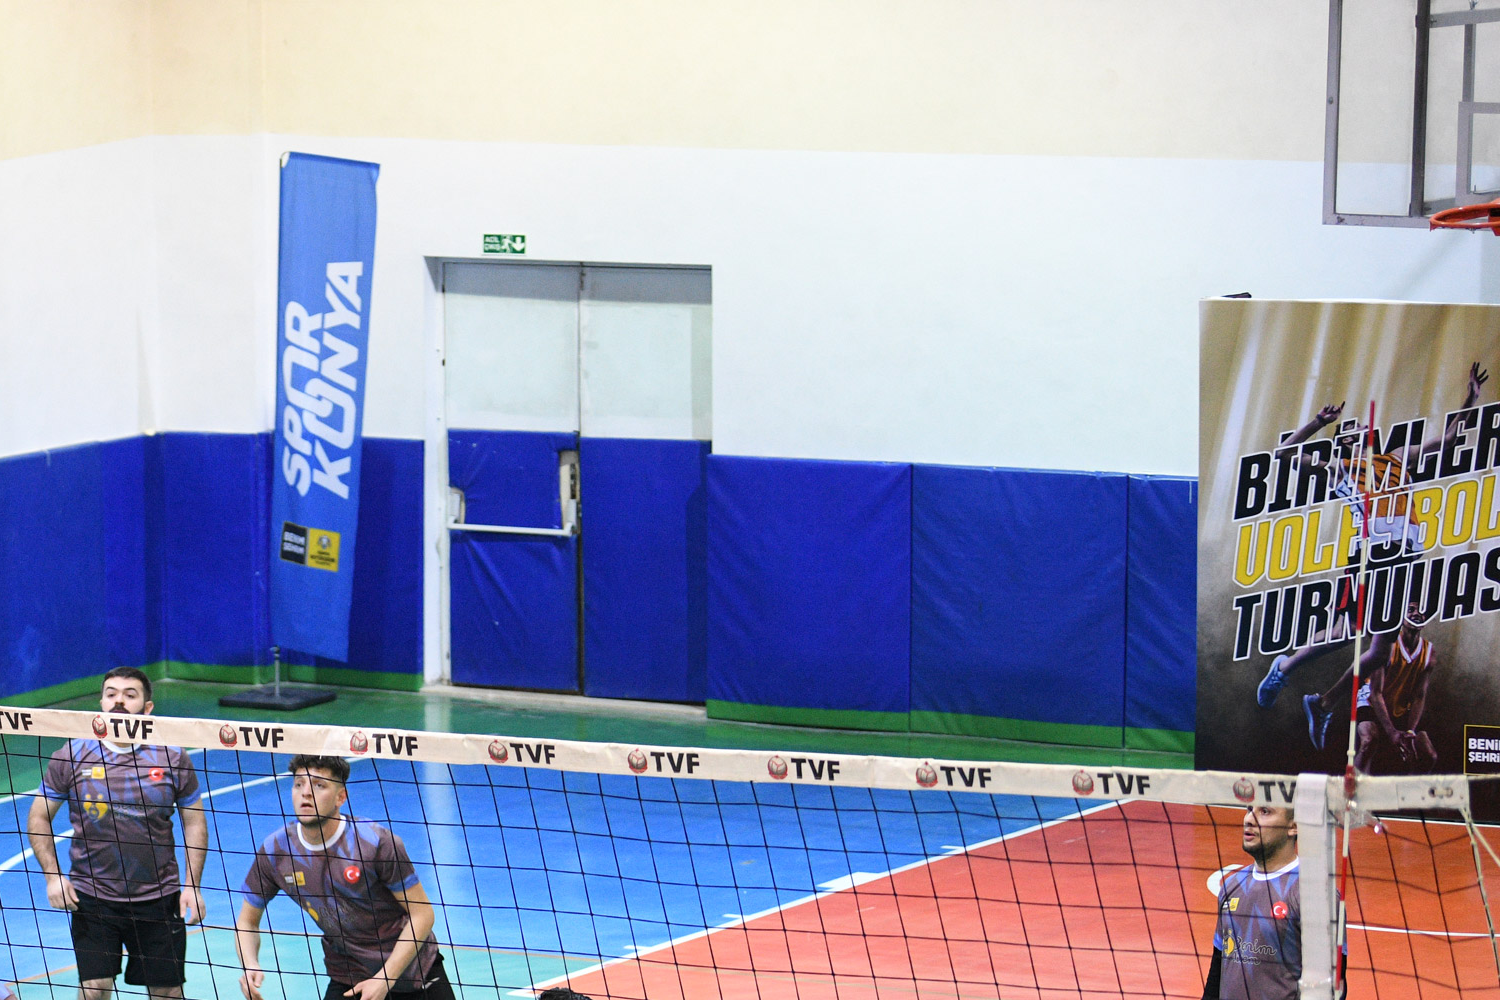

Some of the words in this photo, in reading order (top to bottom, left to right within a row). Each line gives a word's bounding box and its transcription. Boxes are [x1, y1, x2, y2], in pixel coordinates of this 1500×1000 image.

[302, 261, 363, 500] KONYA
[282, 301, 323, 497] SPOR
[110, 718, 154, 740] TVF
[239, 727, 284, 748] TVF
[372, 733, 418, 756] TVF
[509, 743, 556, 764] TVF
[650, 751, 699, 774] TVF
[791, 758, 840, 782] TVF
[940, 765, 992, 789] TVF
[1098, 772, 1150, 796] TVF
